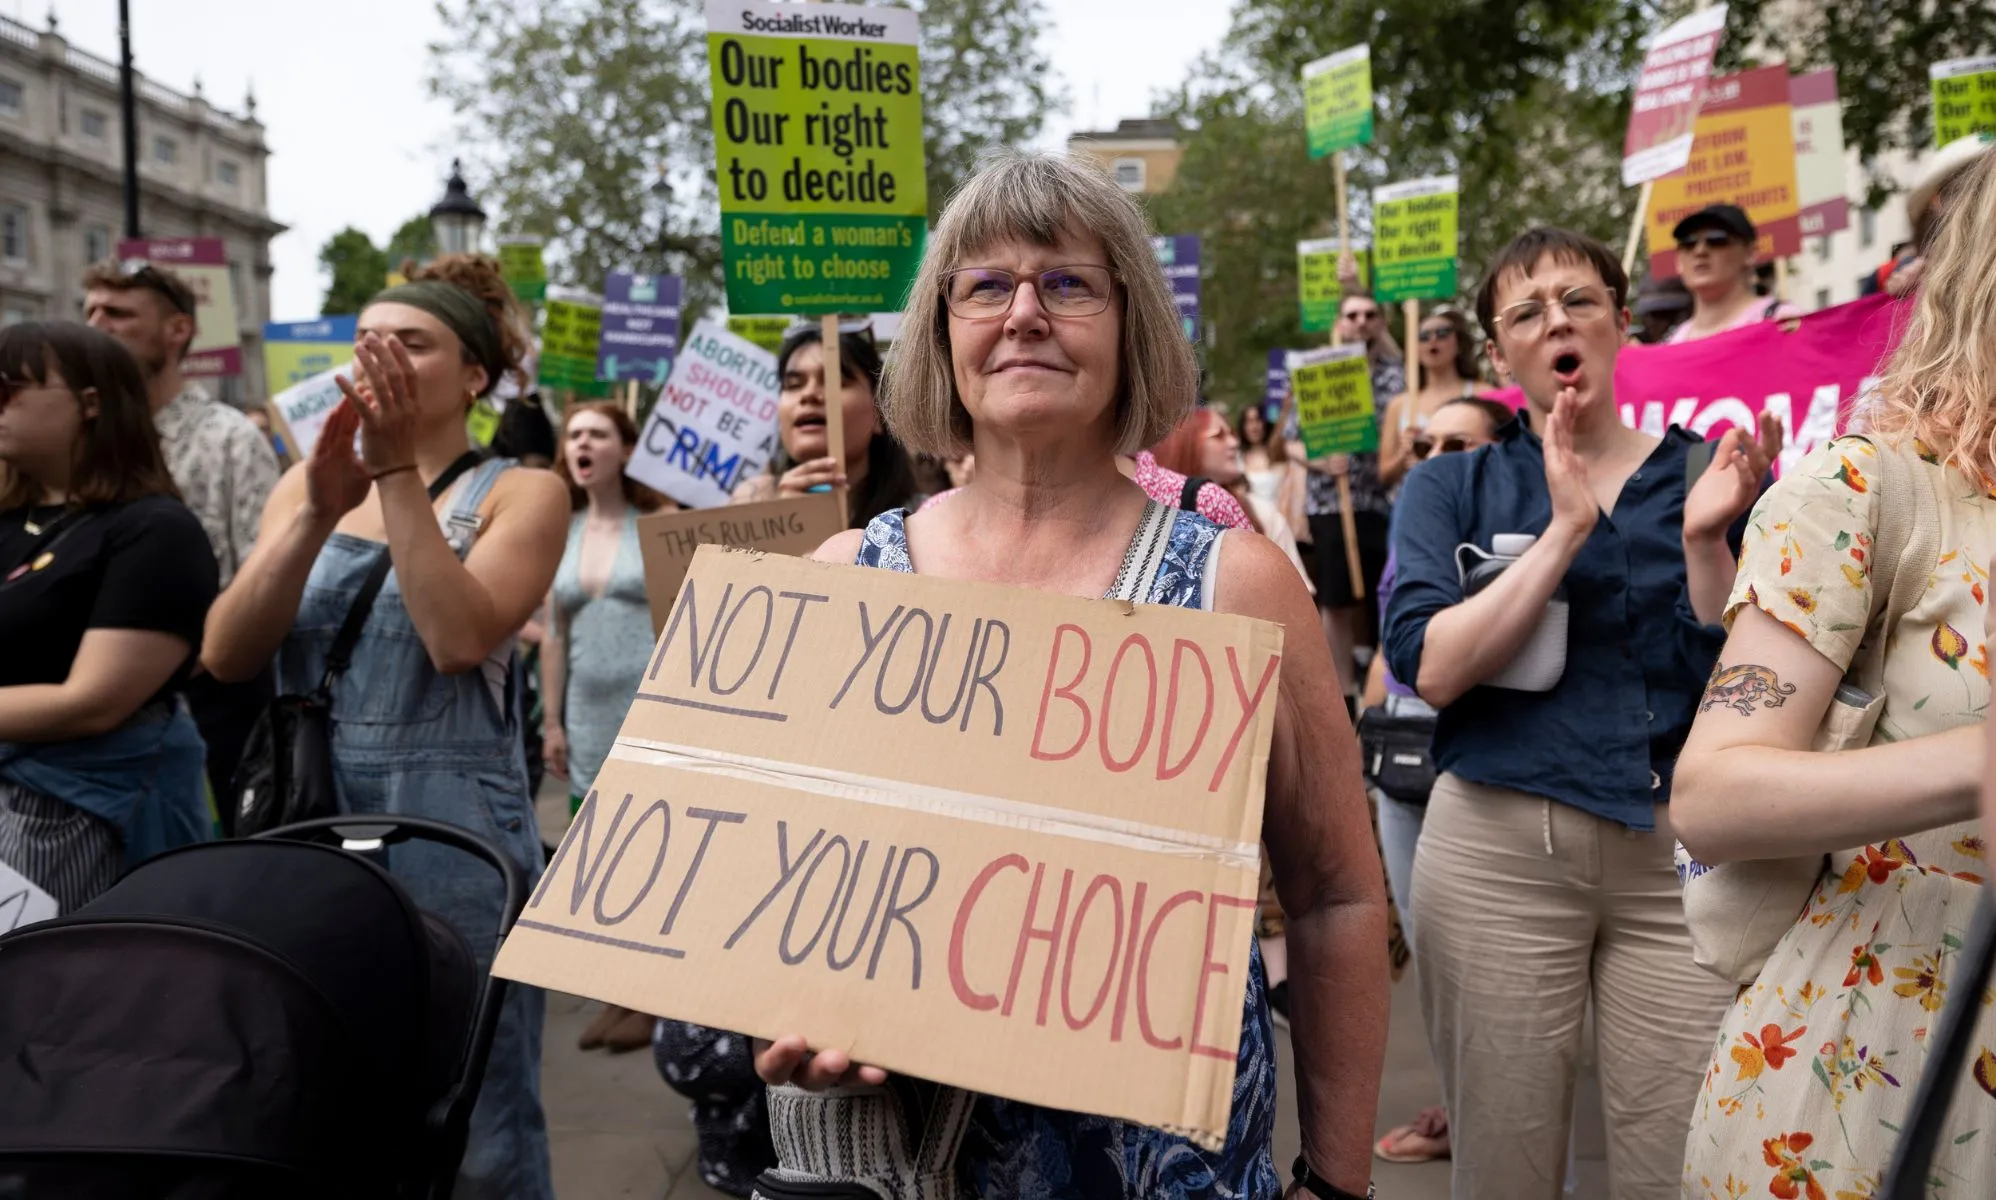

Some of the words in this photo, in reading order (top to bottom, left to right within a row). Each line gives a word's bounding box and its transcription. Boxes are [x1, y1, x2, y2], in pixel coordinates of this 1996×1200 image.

[720, 38, 784, 89] Our
[799, 45, 912, 94] bodies
[1940, 79, 1969, 96] Our
[724, 97, 789, 145] Our
[805, 101, 889, 157] right
[1940, 102, 1970, 119] Our
[729, 157, 768, 201] to
[783, 156, 896, 203] decide
[732, 219, 805, 246] Defend
[812, 226, 825, 246] a
[832, 221, 912, 248] woman's
[736, 254, 785, 285] right
[792, 254, 815, 279] to
[822, 254, 890, 280] choose
[690, 334, 779, 391] ABORTIO
[665, 384, 711, 419] NOT
[717, 411, 750, 441] BE
[757, 433, 773, 453] A
[687, 361, 777, 422] SHOULD
[645, 410, 760, 496] CRIME
[658, 522, 716, 558] THIS
[719, 512, 805, 546] RULING
[648, 578, 829, 700] NOT
[830, 600, 1010, 736] YOUR
[1030, 623, 1281, 793] BODY
[529, 789, 747, 936] NOT
[722, 820, 940, 990] YOUR
[947, 853, 1257, 1061] CHOICE
